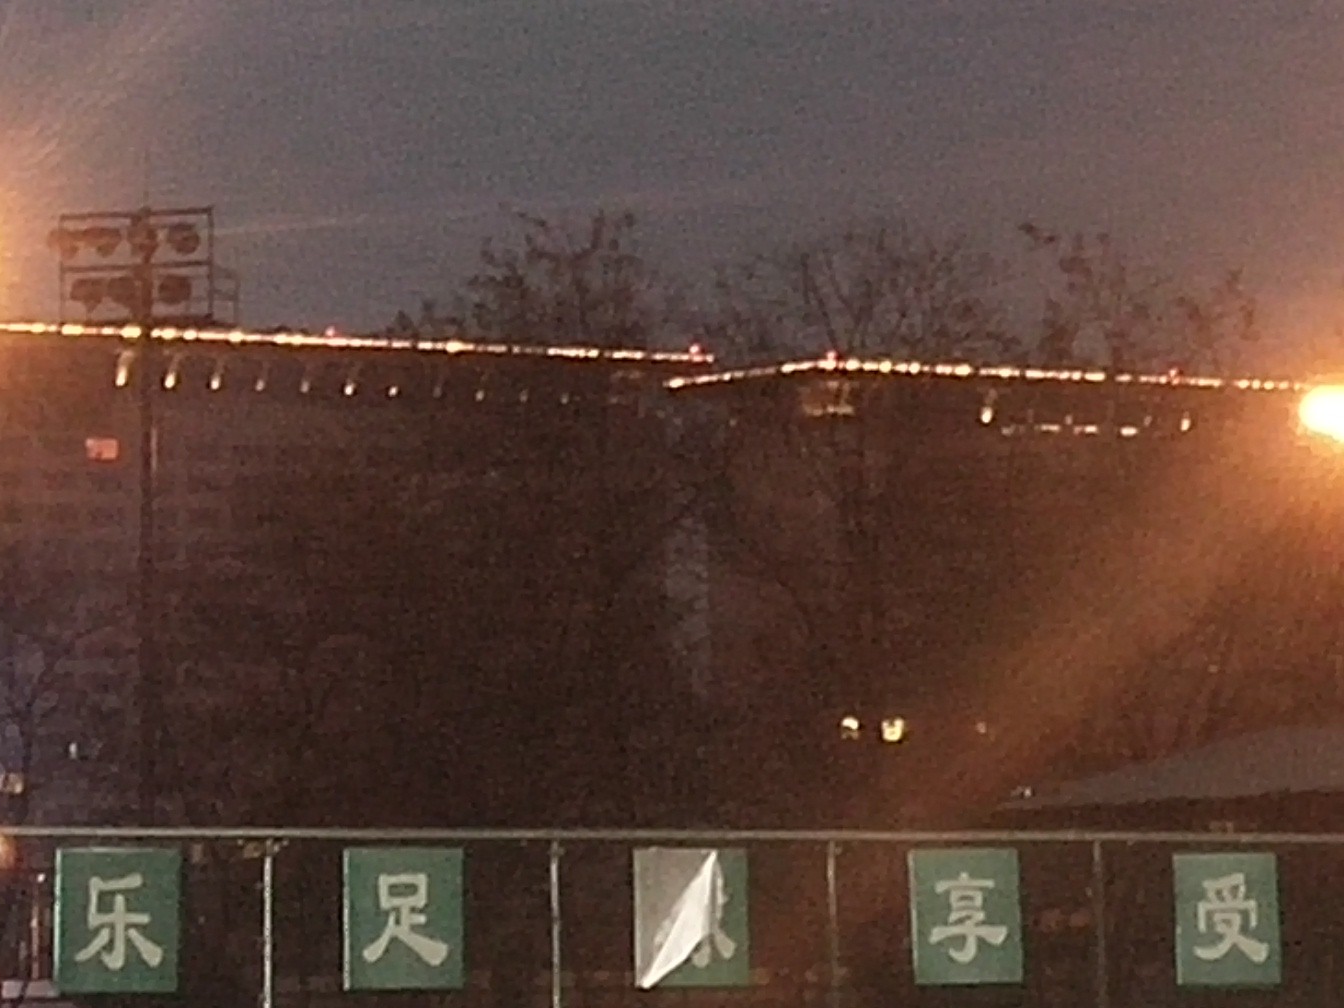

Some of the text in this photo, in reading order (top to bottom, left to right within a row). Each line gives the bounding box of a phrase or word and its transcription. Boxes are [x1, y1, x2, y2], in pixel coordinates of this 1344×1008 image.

[74, 872, 164, 971] 乐
[362, 872, 449, 967] 足
[928, 871, 1009, 964] 享
[1192, 872, 1269, 964] 受
